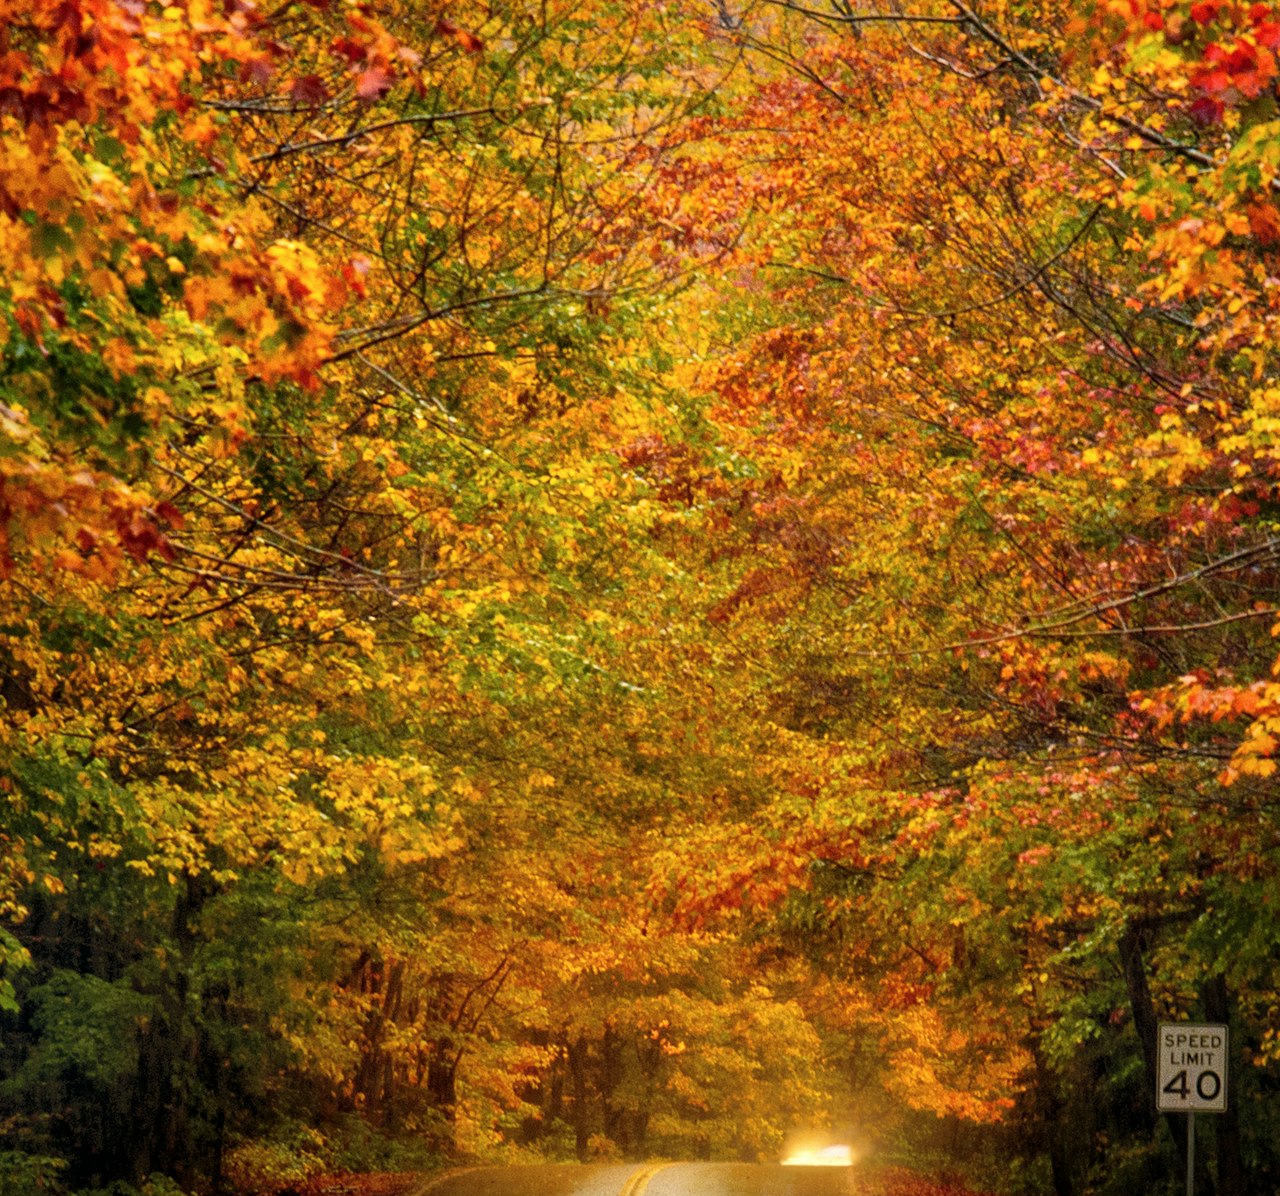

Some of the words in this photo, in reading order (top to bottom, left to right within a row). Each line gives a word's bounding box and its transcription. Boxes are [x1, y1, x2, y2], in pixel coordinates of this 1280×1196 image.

[1165, 1035, 1221, 1048] SPEED
[1170, 1053, 1214, 1065] LIMIT
[1163, 1070, 1221, 1101] 40
